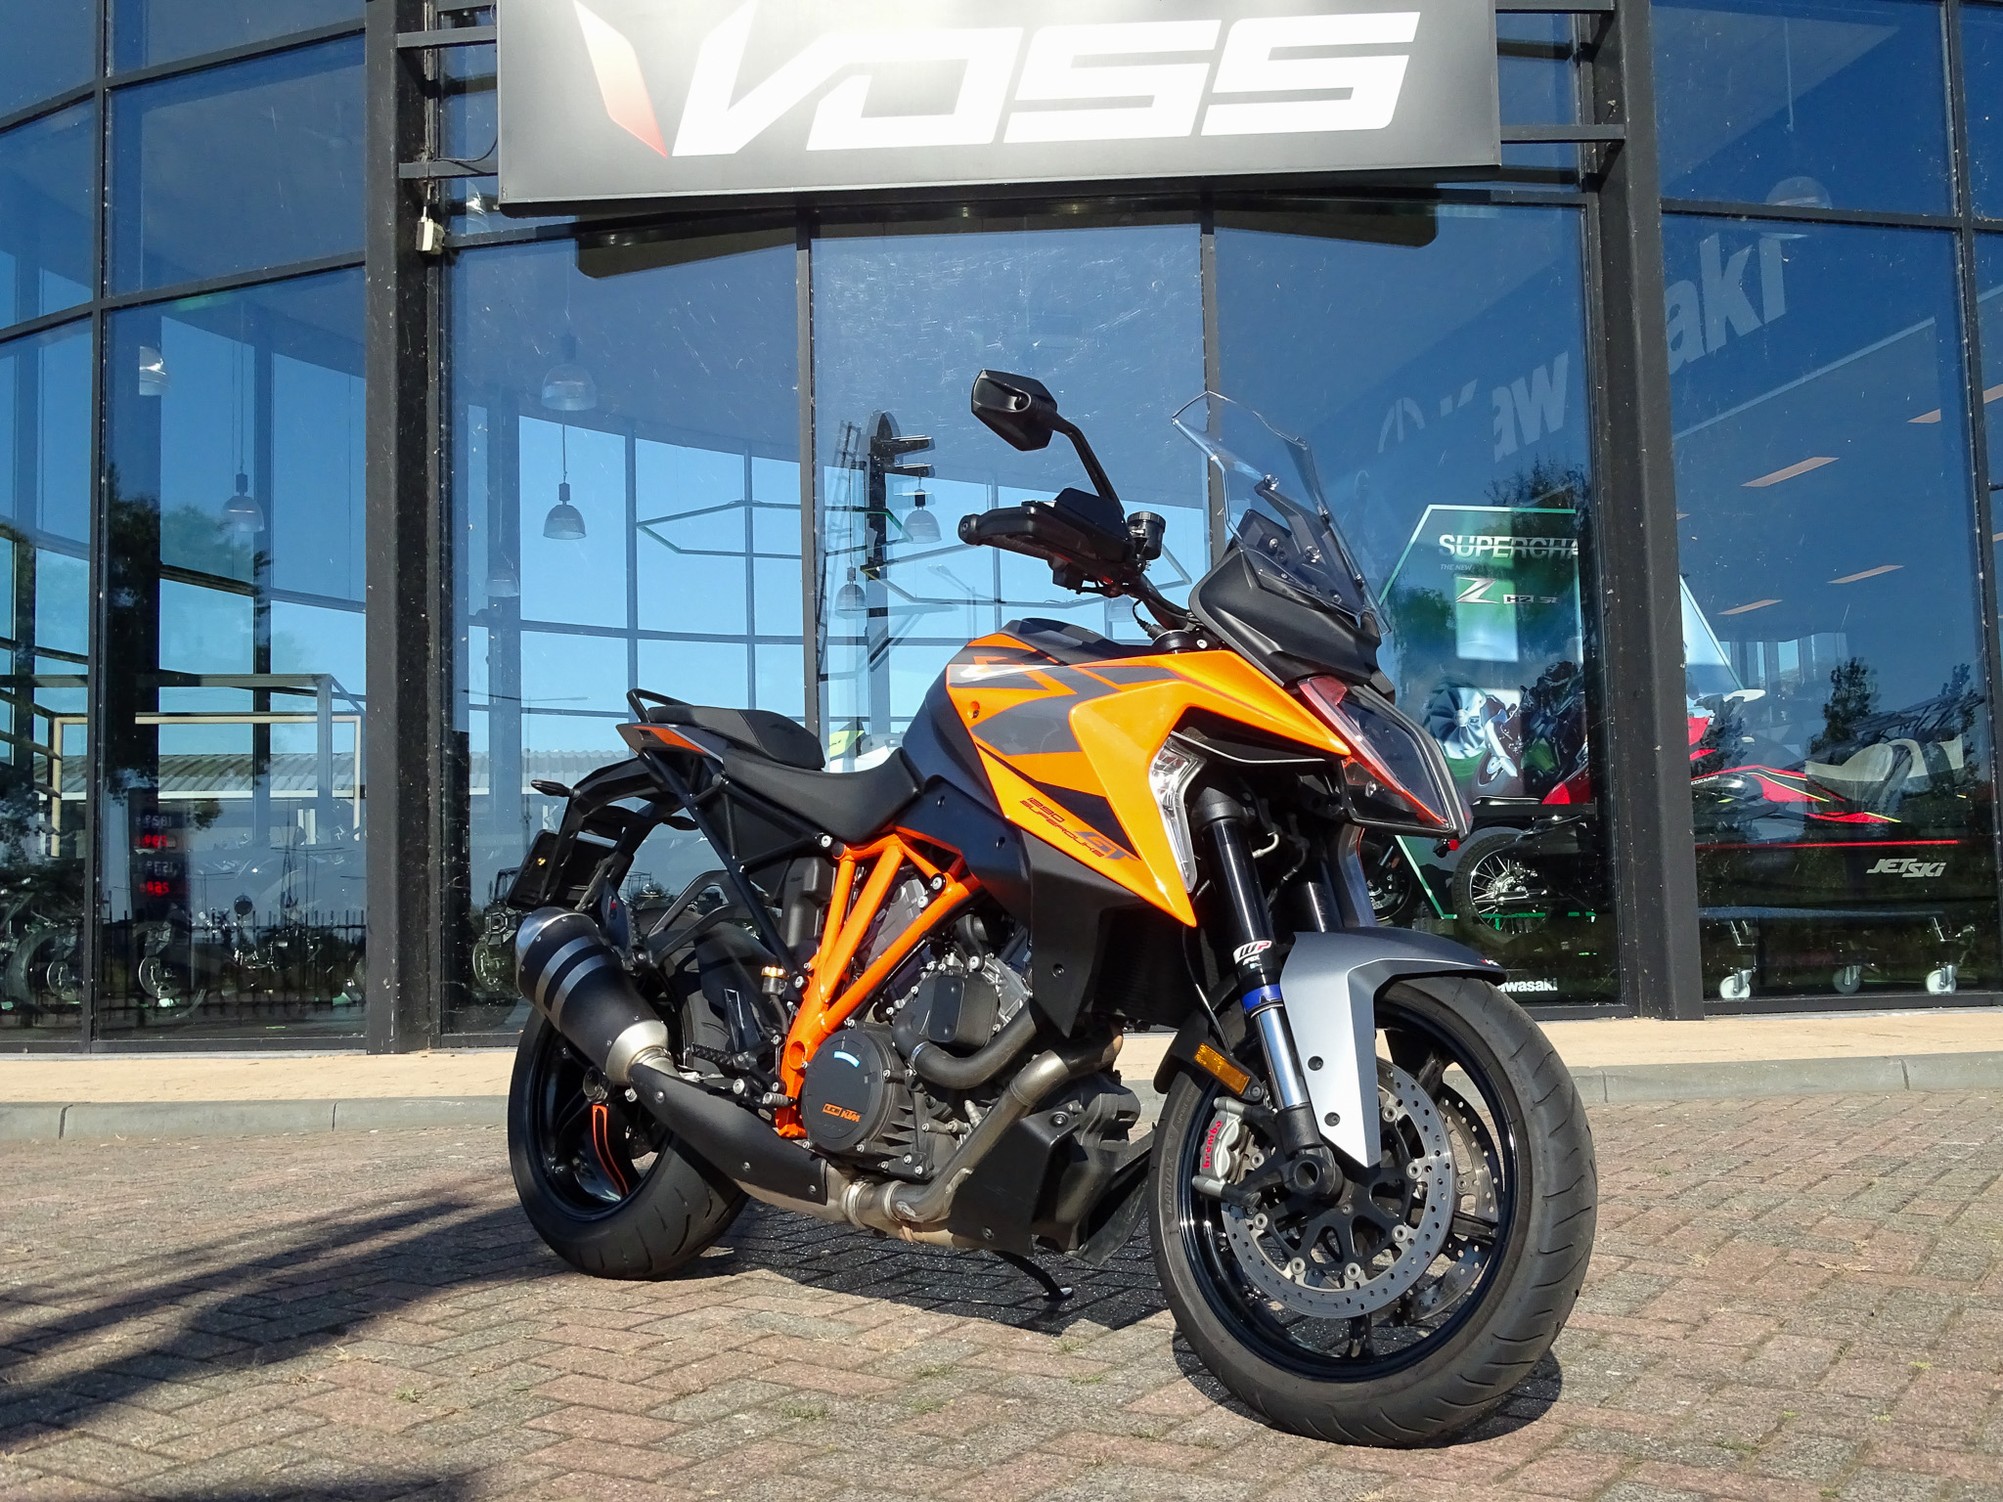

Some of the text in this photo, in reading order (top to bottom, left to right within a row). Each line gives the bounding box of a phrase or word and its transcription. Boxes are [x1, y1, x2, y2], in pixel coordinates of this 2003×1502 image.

[671, 0, 1421, 156] VOSS
[1456, 563, 1473, 571] NEW
[1496, 978, 1559, 992] awasaki
[1202, 1120, 1223, 1169] brembo
